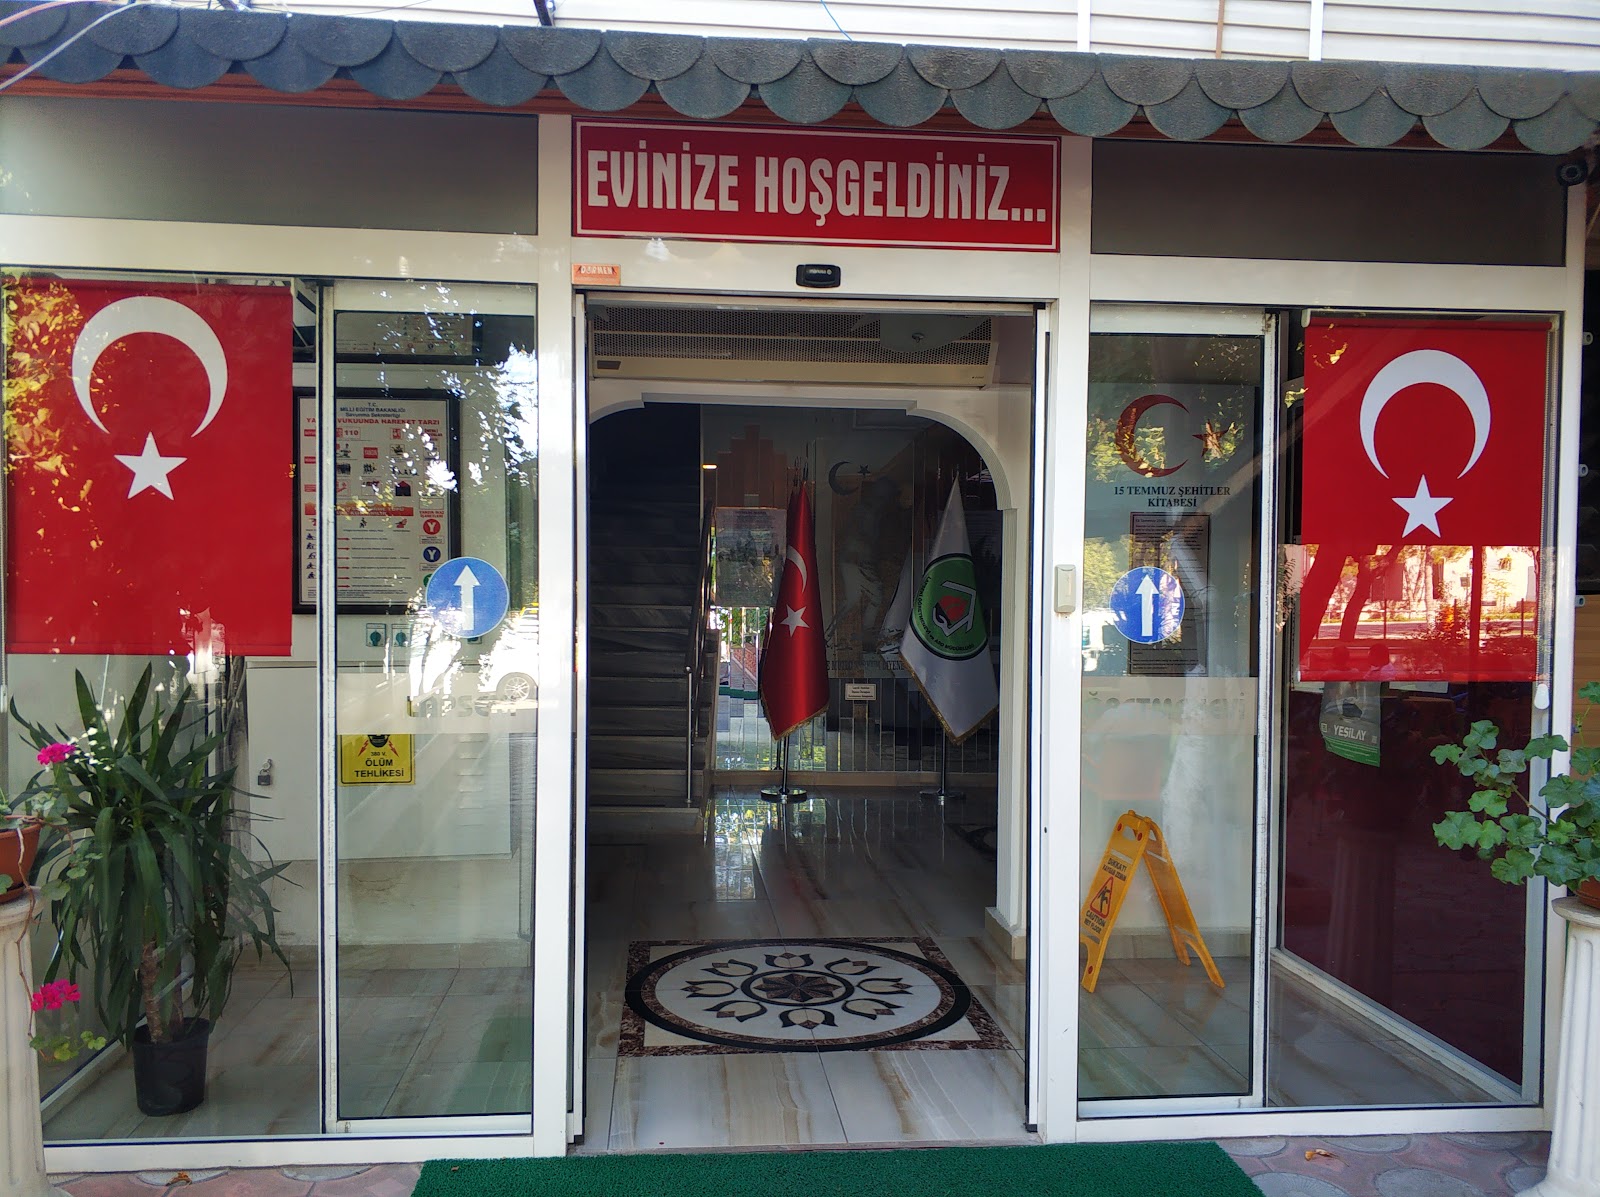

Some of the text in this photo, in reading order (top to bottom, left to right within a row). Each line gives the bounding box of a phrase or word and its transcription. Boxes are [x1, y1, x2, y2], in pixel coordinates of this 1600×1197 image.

[587, 139, 1047, 227] EVİNİZE HOŞGELDİNİZ...
[1114, 484, 1231, 497] 15 TEMMUZ ŞEHİTLER
[1147, 495, 1197, 507] KİTABESİ
[427, 521, 437, 533] Y
[427, 549, 437, 561] Y
[365, 757, 393, 767] ÖLÜM
[354, 768, 404, 778] TEHLİKESİ
[1086, 910, 1106, 927] CAUTION
